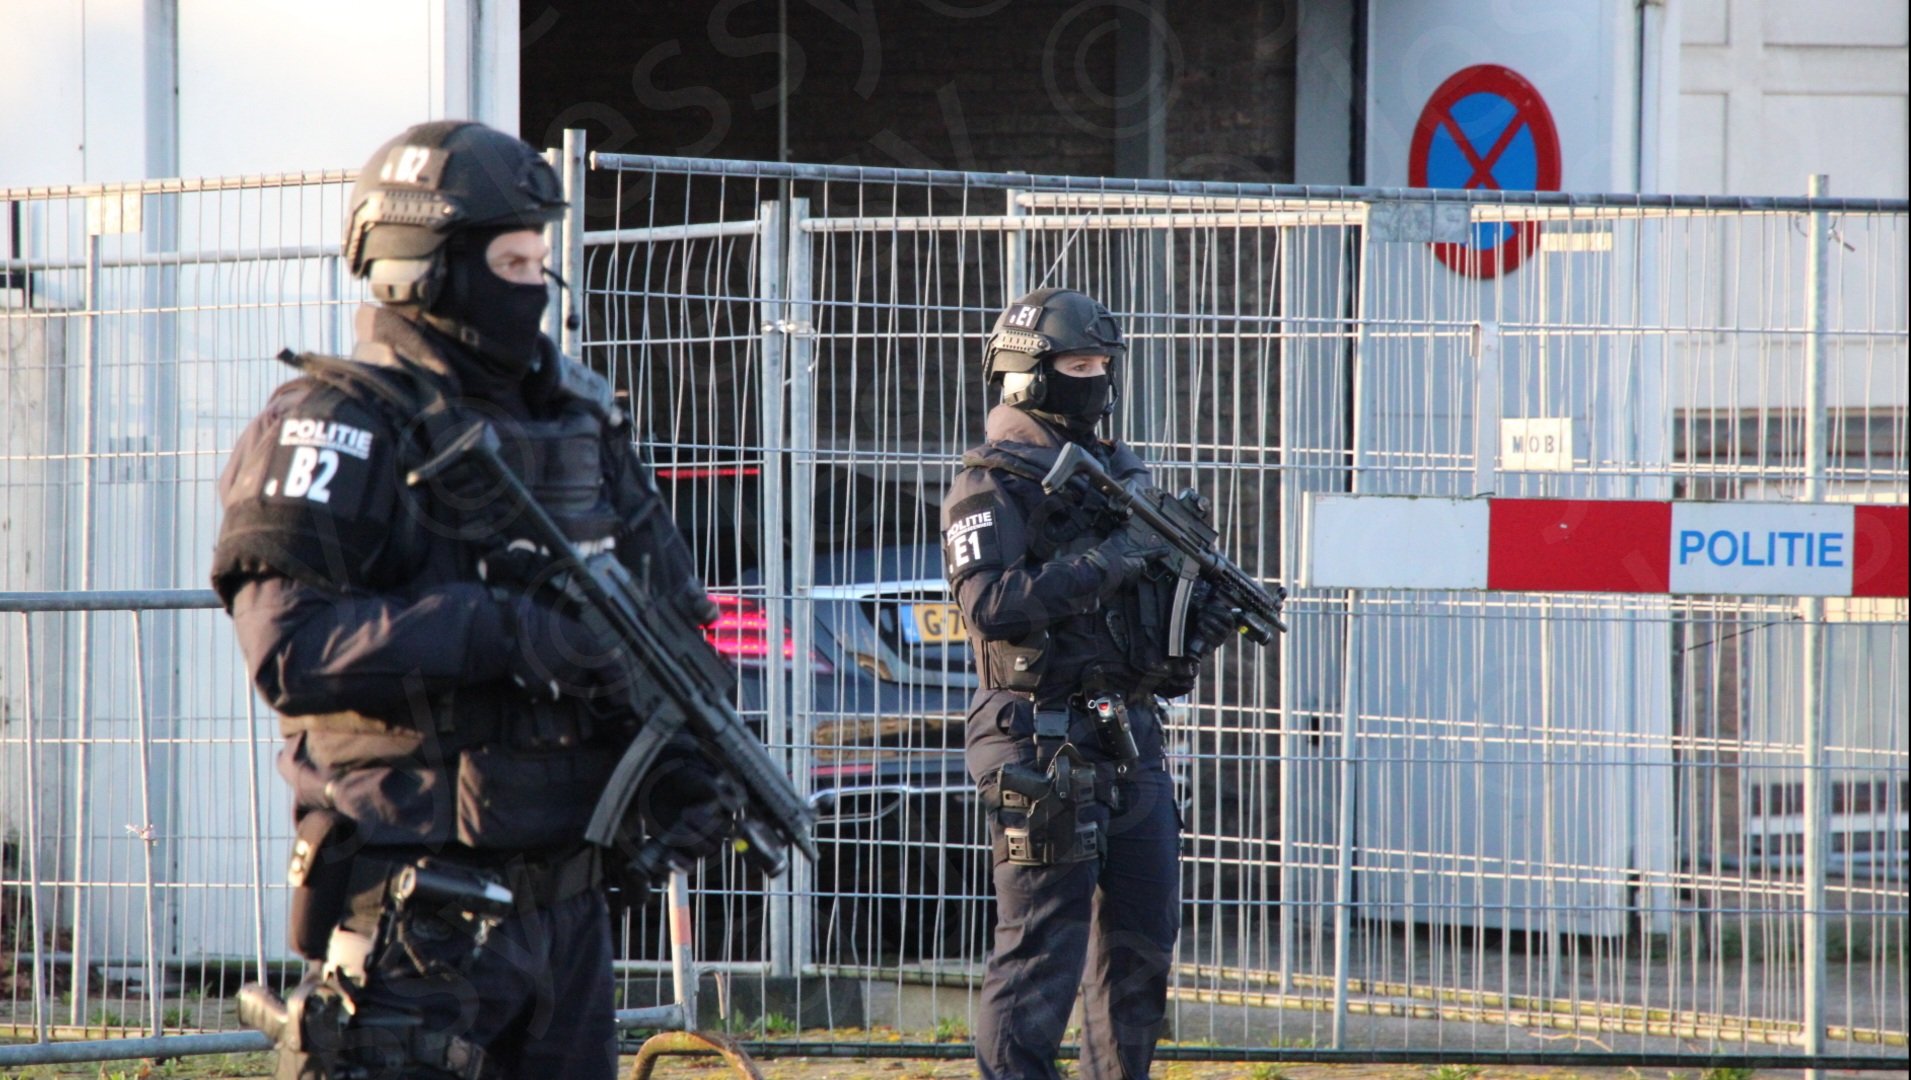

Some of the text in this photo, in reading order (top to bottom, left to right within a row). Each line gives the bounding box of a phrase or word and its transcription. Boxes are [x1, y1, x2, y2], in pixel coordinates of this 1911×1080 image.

[281, 419, 373, 450] POLITIE
[946, 511, 992, 540] POLITIE
[1679, 530, 1843, 567] POLITIE
